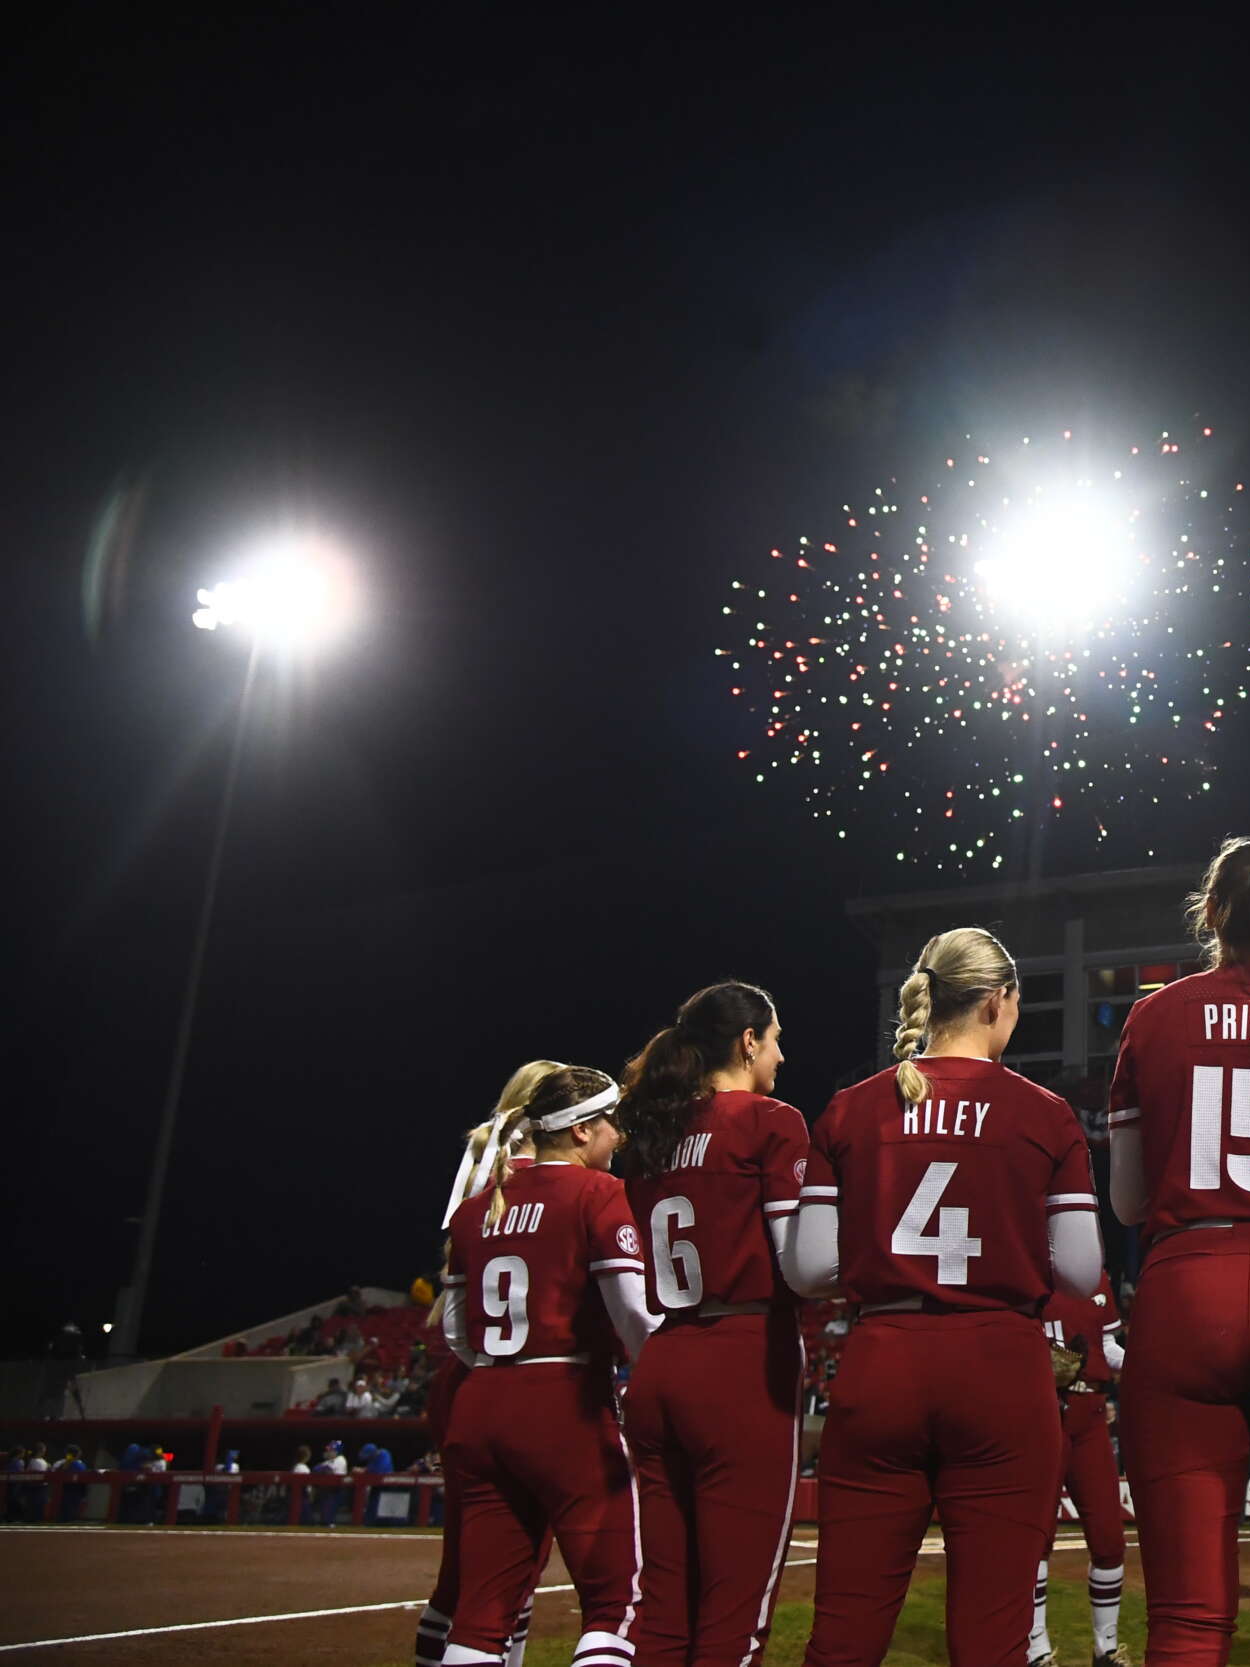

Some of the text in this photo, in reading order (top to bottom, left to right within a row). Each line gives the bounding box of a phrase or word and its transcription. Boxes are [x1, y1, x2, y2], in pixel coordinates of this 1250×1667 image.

[903, 1099, 992, 1138] RILEY
[481, 1202, 545, 1239] CLOUD
[650, 1195, 704, 1310] 6
[891, 1161, 983, 1286] 4
[481, 1255, 530, 1357] 9
